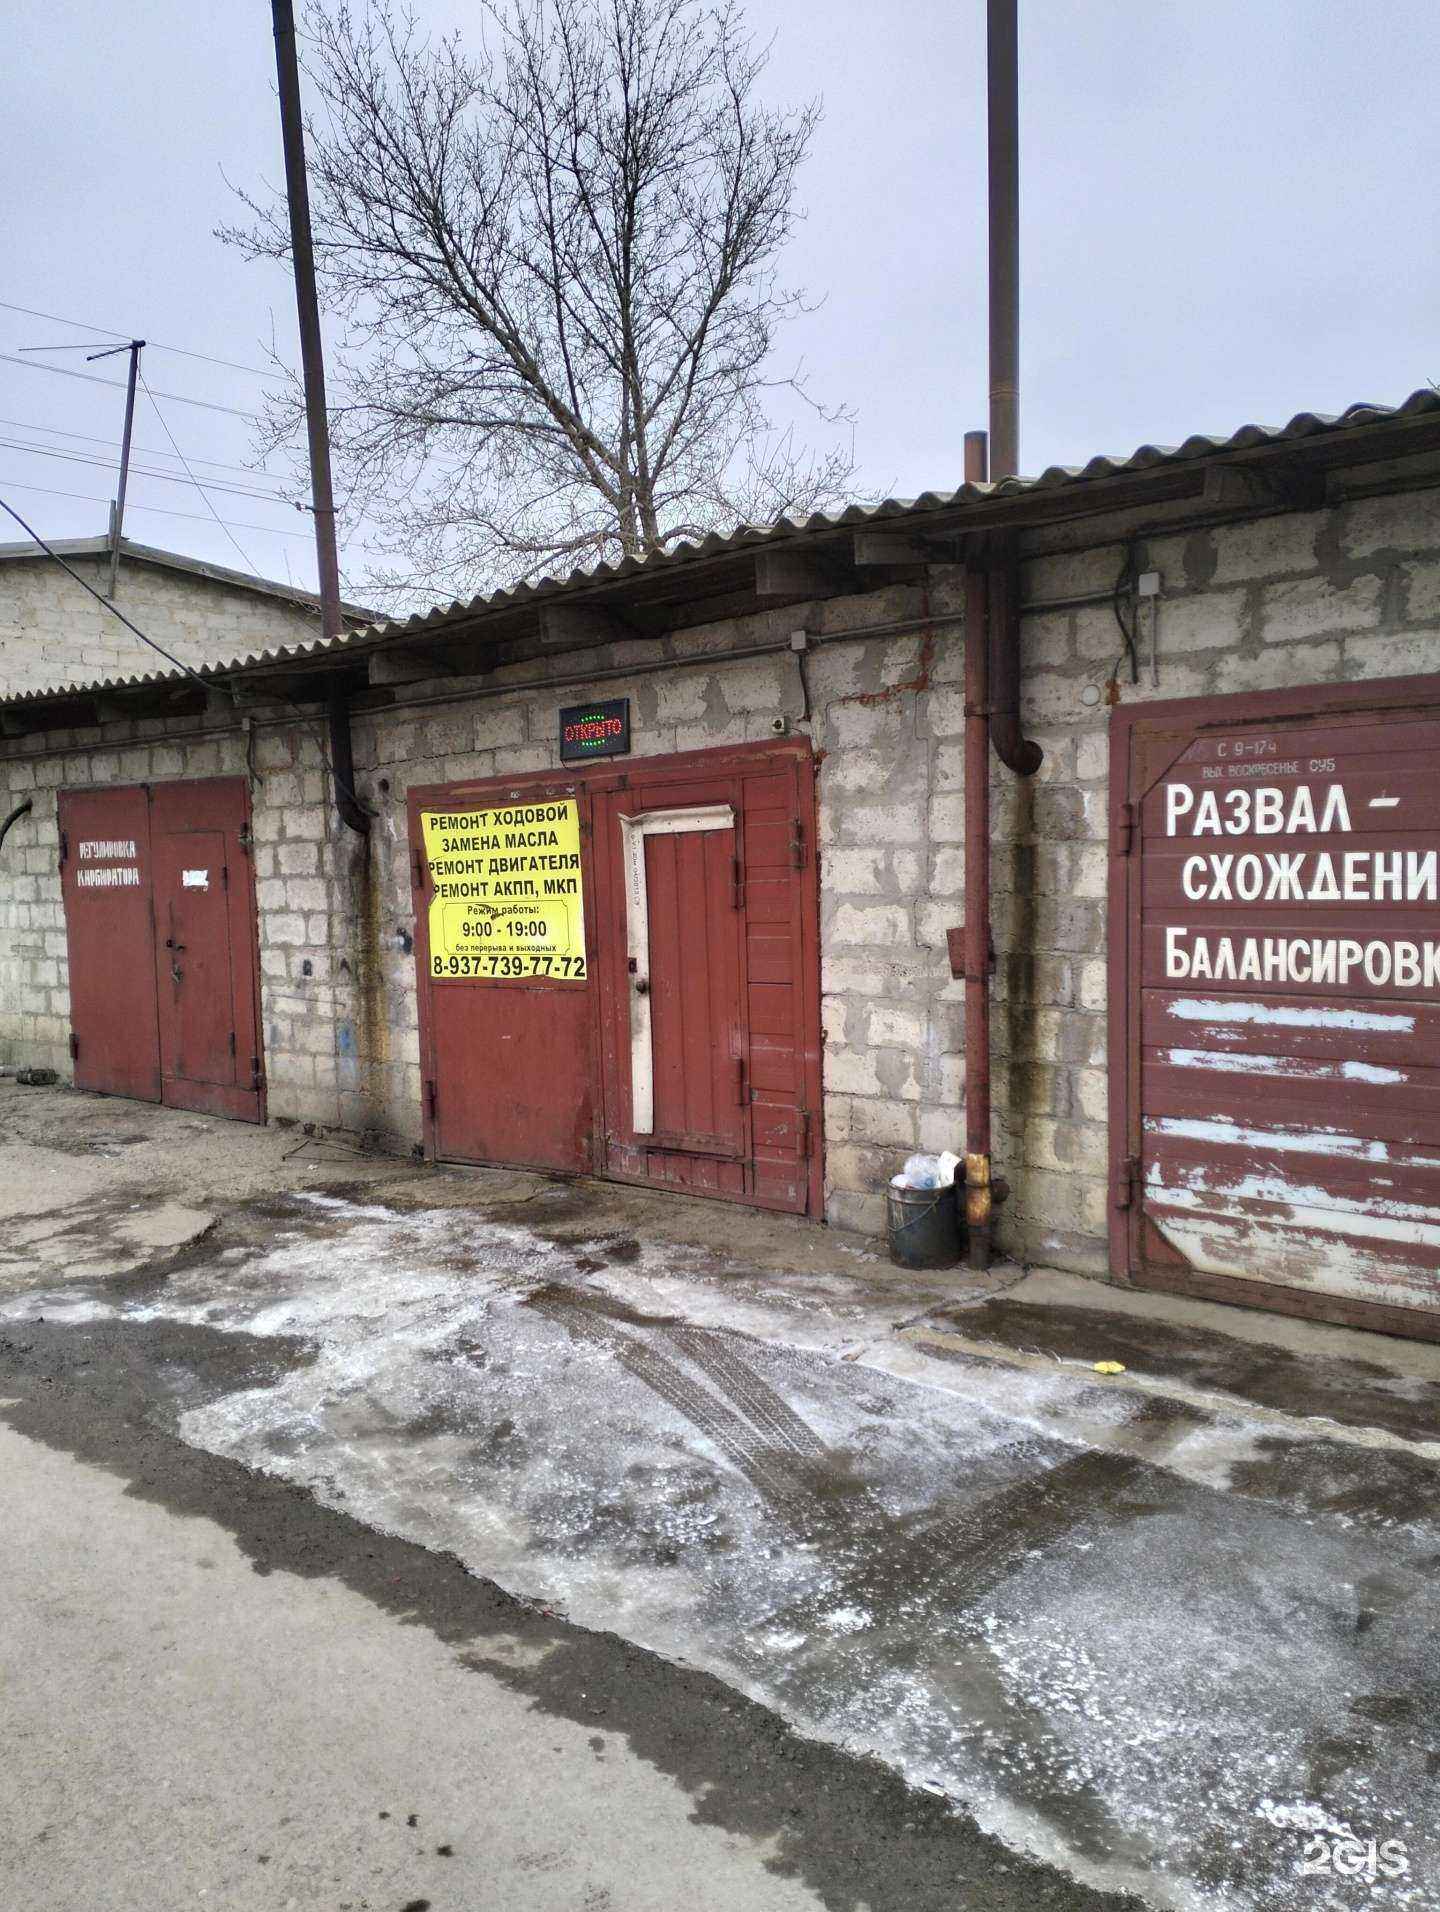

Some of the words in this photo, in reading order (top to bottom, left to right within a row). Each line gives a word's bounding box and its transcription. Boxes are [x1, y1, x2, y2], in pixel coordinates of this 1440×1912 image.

[565, 718, 622, 742] ОТКРЫТО
[430, 813, 488, 831] РЕМОНТ
[493, 801, 568, 827] ХОДОВОЙ
[1166, 783, 1352, 837] РАЗВАЛ
[442, 835, 501, 852] ЗАМЕНА
[505, 831, 559, 848] МАСЛА
[429, 859, 483, 876] РЕМОНТ
[488, 853, 580, 876] ДВИГАТЕЛЯ
[1182, 851, 1438, 901] СХОЖДЕНИ
[493, 880, 539, 898] АКПП,
[544, 878, 577, 894] МКП
[467, 905, 499, 915] Режим
[502, 904, 540, 916] работы:
[462, 921, 492, 937] 9:00
[506, 920, 547, 937] 19:00
[455, 943, 469, 952] без
[470, 944, 507, 954] перерыва
[516, 944, 557, 953] выходных
[433, 955, 586, 977] 8-937-739-77-72
